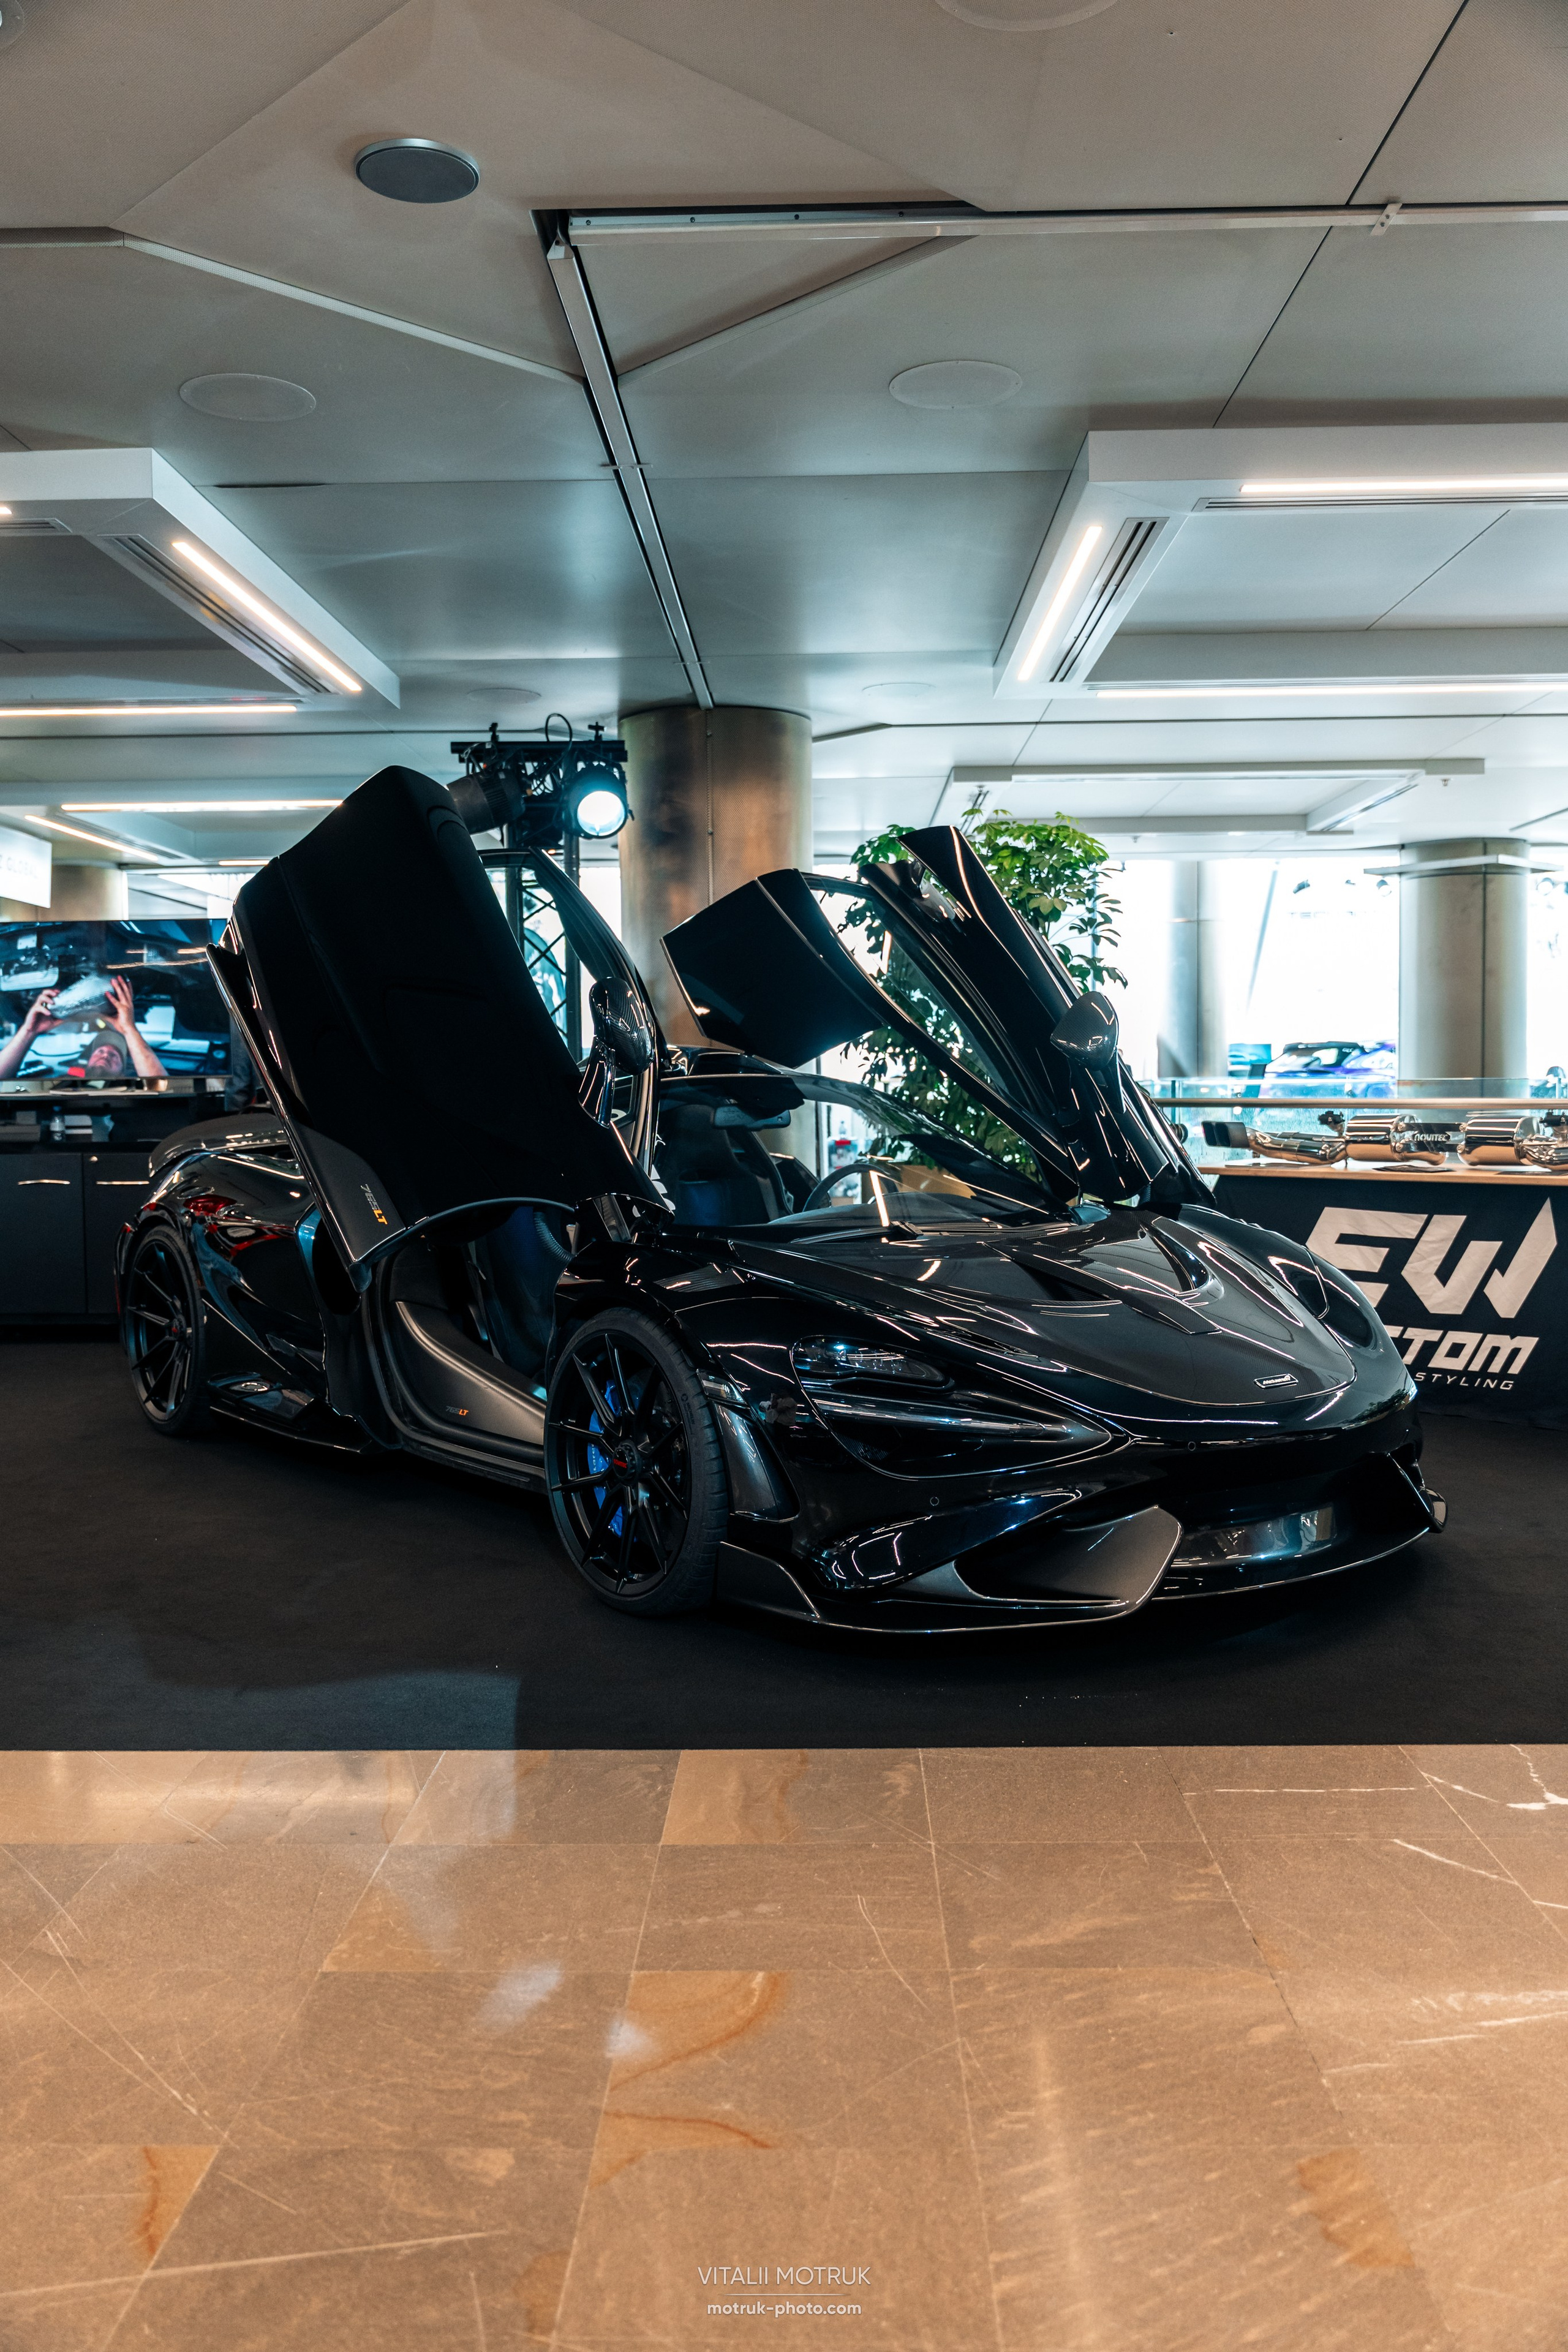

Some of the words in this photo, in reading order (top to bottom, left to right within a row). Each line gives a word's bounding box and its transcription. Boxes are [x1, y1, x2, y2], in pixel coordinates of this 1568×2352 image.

[360, 1183, 388, 1225] 765LT
[1385, 1324, 1540, 1374] TOM
[1414, 1372, 1515, 1390] STYLING
[446, 1406, 469, 1415] 765LT
